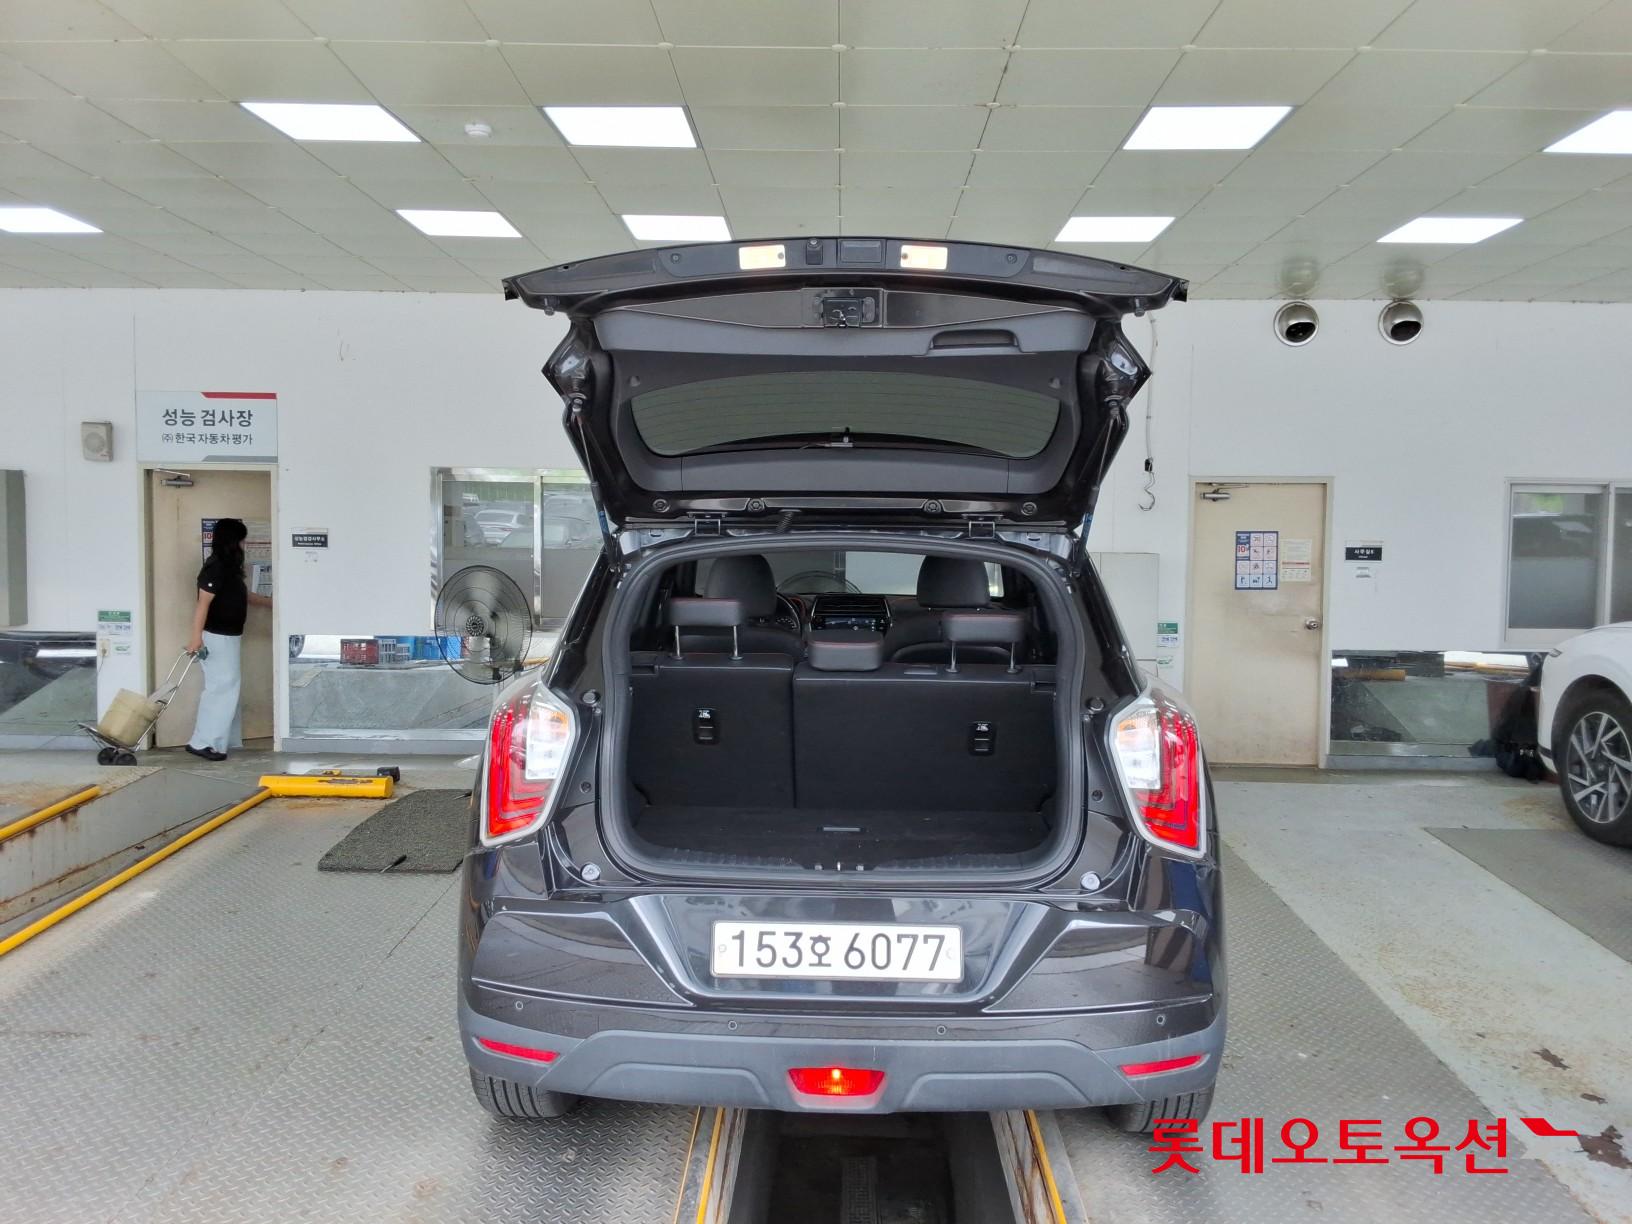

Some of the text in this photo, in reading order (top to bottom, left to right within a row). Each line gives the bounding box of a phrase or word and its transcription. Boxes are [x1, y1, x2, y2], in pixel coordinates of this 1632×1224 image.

[162, 408, 254, 427] 성능 검사장
[843, 932, 946, 972] 6077
